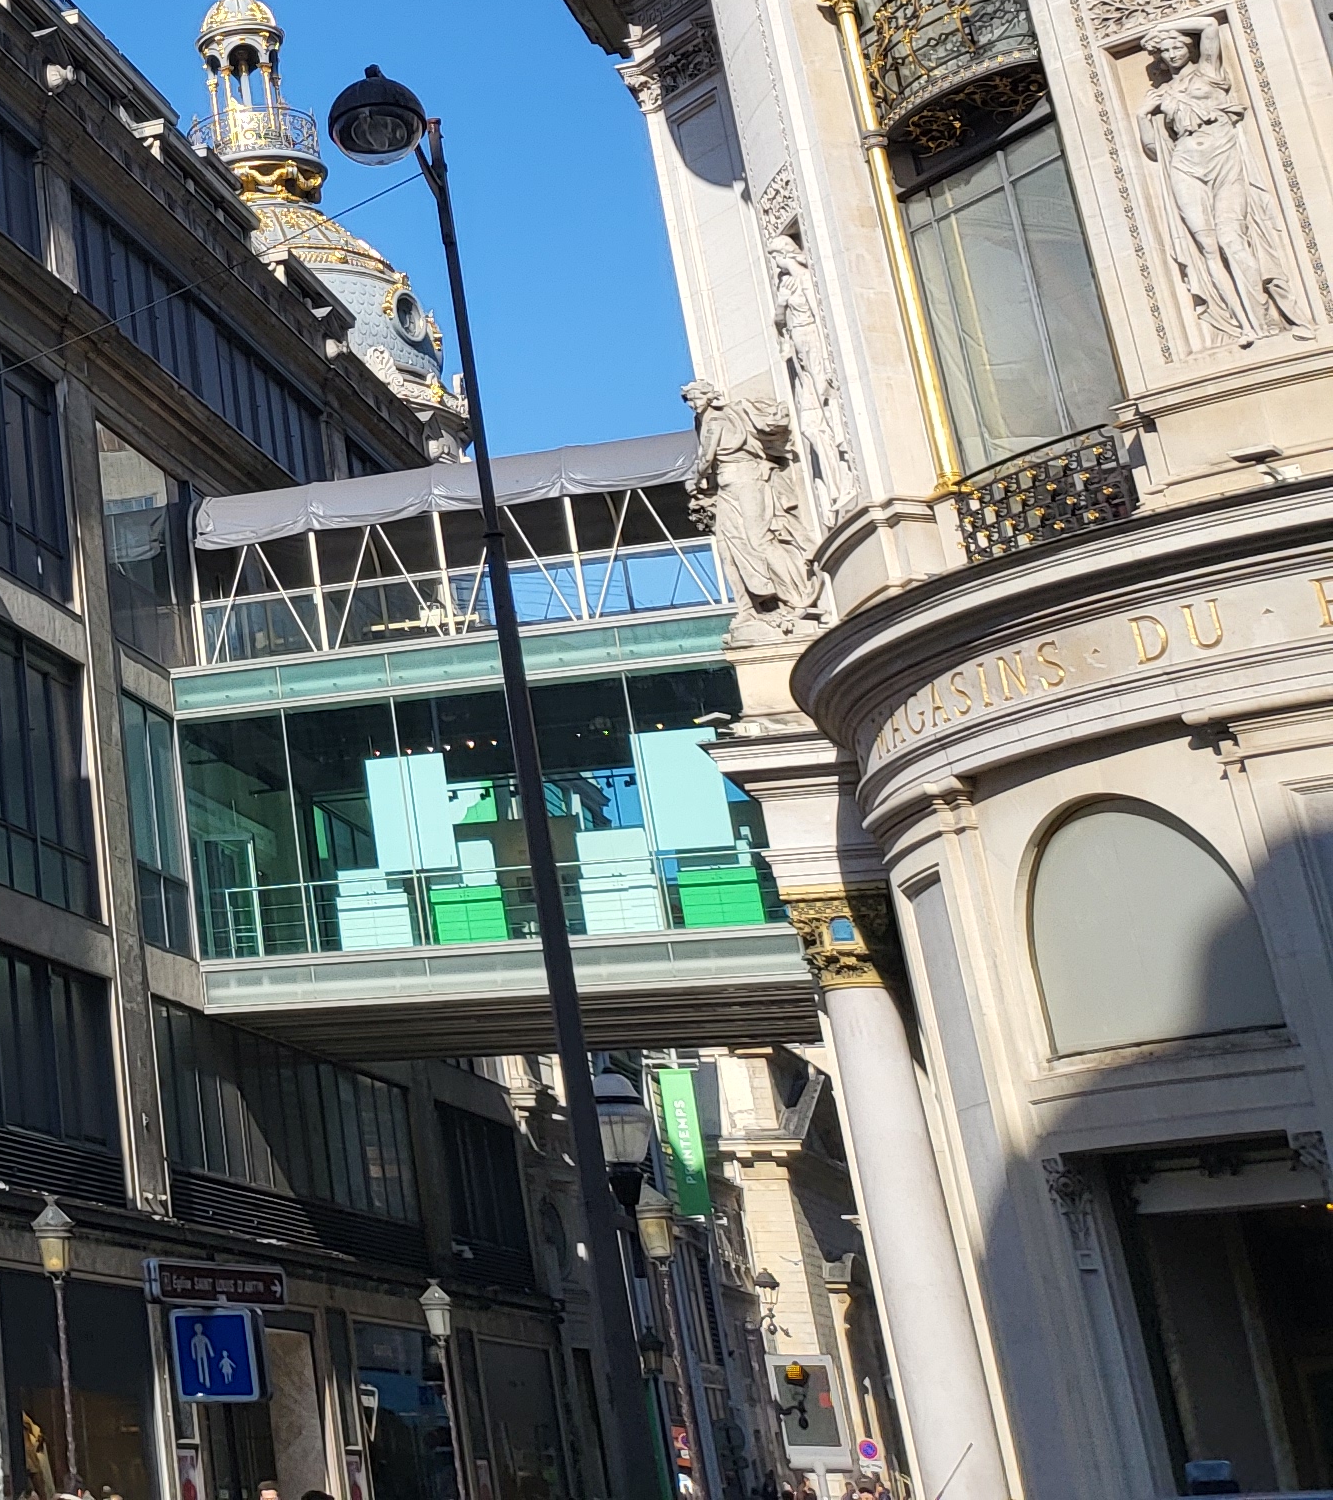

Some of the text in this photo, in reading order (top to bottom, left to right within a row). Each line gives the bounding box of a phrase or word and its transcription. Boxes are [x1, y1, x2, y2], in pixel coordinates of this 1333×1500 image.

[873, 638, 1066, 760] MAGASINS
[1127, 597, 1225, 666] DU
[673, 1099, 697, 1185] PRINTEMPS
